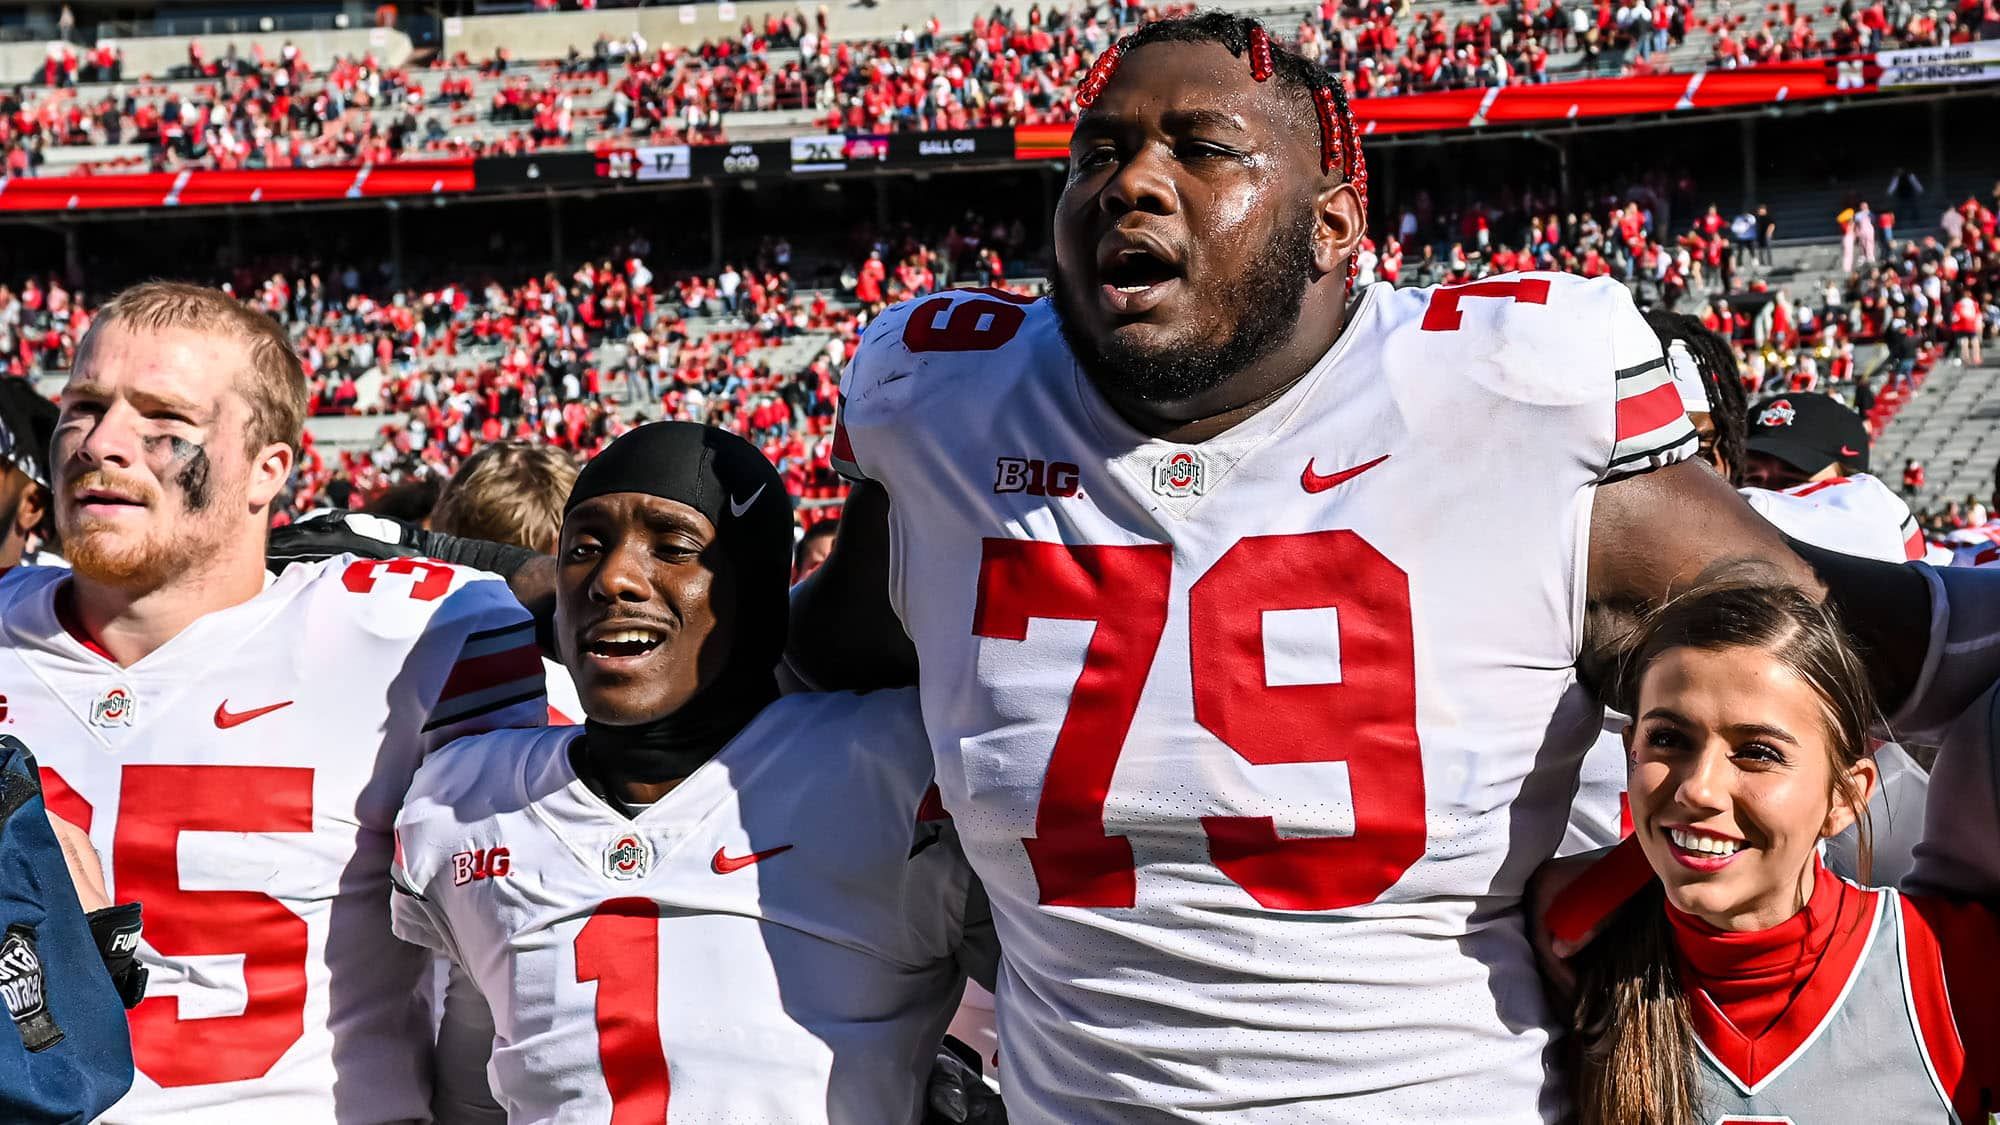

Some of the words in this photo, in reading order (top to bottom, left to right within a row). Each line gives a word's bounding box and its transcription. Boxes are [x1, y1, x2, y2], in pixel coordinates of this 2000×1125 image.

[1893, 63, 1985, 83] JOHNSON
[805, 143, 832, 160] 26
[919, 141, 950, 155] BALL
[952, 139, 976, 153] ON
[655, 153, 675, 173] 17
[1179, 461, 1200, 484] STATE
[972, 529, 1427, 911] 79
[39, 764, 315, 1088] 5
[573, 896, 671, 1125] 1
